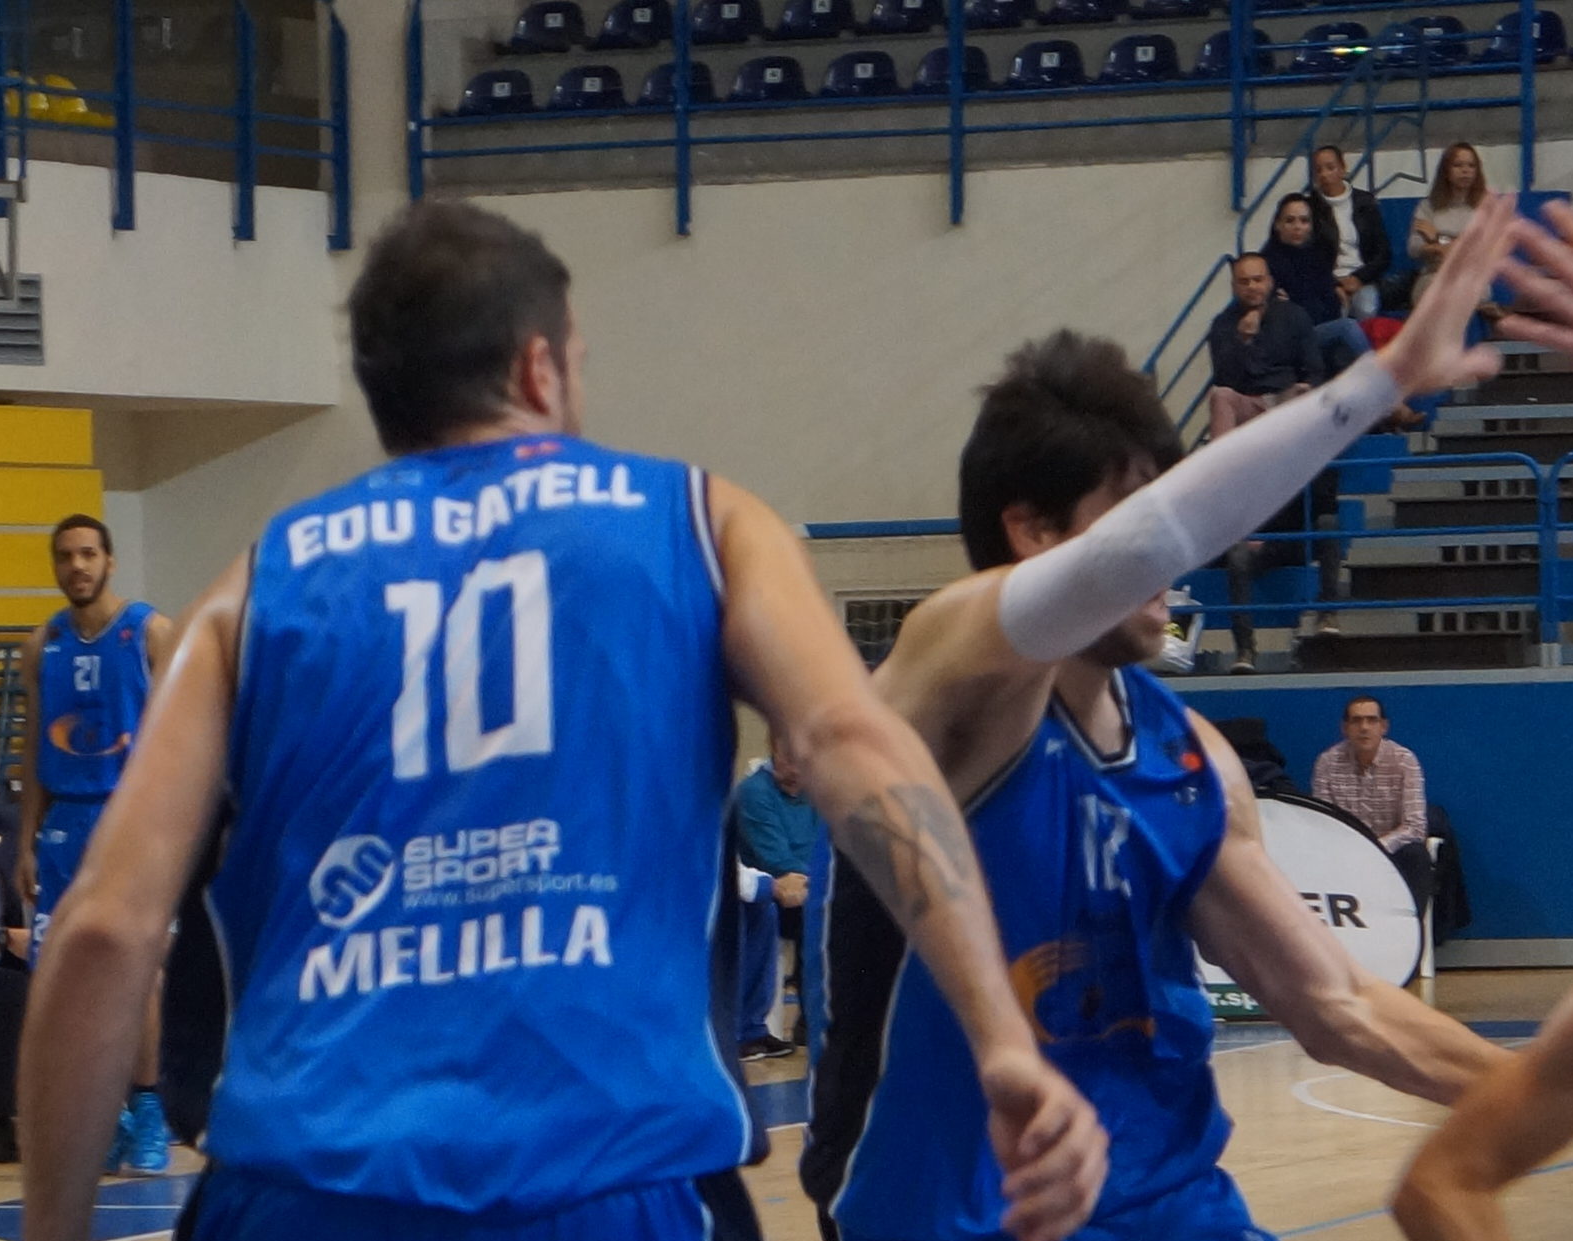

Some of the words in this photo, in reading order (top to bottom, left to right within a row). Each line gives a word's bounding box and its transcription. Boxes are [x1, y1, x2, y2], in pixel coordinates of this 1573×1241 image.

[433, 463, 646, 545] GATELL
[73, 655, 102, 691] 21
[384, 549, 553, 780] 10
[403, 818, 561, 867] SUPER
[403, 845, 561, 892] SPORT
[299, 904, 615, 1001] MELILLA
